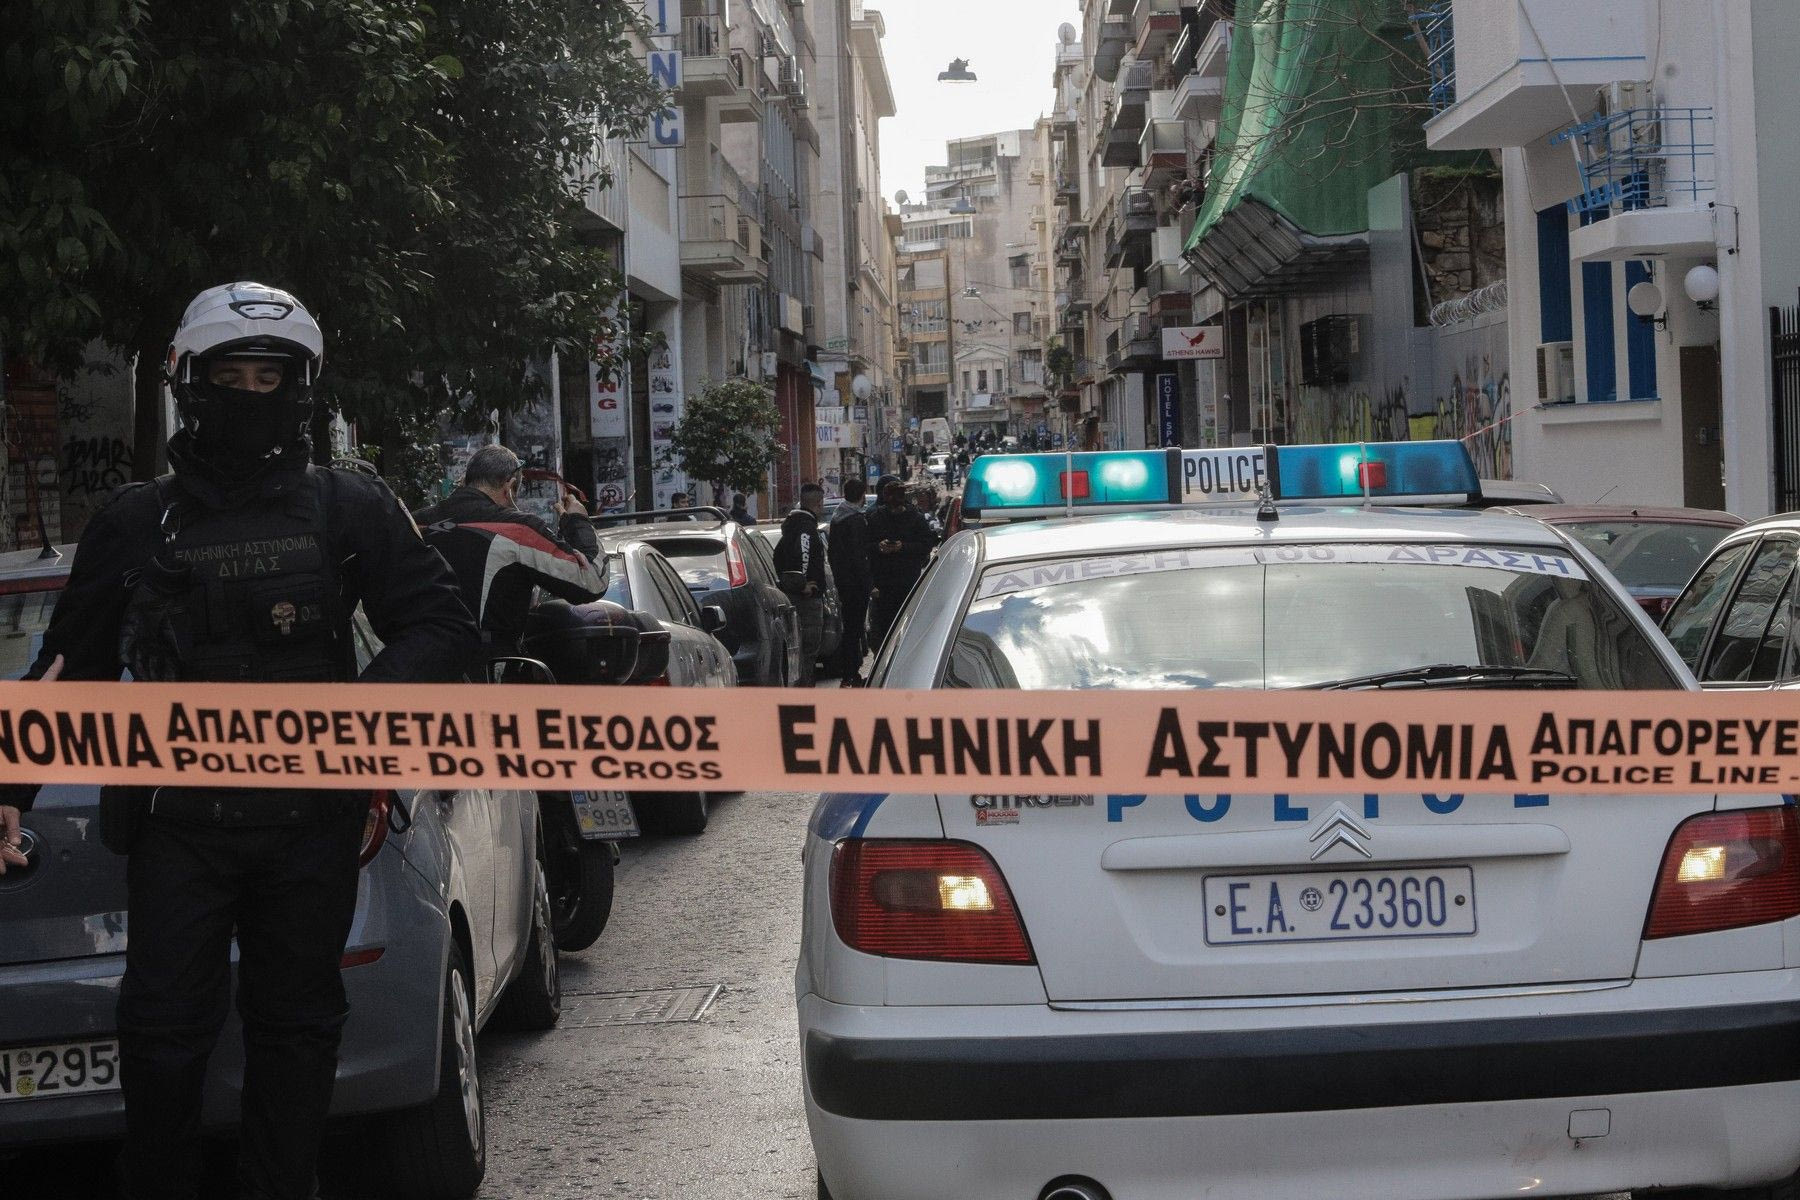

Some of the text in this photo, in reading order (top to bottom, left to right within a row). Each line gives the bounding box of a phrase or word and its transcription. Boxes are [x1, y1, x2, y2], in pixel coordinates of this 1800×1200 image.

[1166, 348, 1221, 357] ATHENS HAWKS
[1164, 378, 1173, 418] HOTEL
[1184, 454, 1266, 495] POLICE
[244, 535, 318, 556] ΑΣΤΥΝΟΜΙΑ
[990, 551, 1190, 595] ΑΜΕΣΗ
[1387, 548, 1571, 575] ΔΡΑΣΗ
[167, 702, 476, 748] ΑΠΑΓΟΡΕΥΕΤΑΙ
[491, 713, 520, 749] Η
[536, 709, 720, 751] ΕΙΣΟΔΟΣ
[778, 704, 1103, 777] ΕΛΛΗΝΙΚΗ
[1146, 706, 1518, 782] ΑΣΤΥΝΟΜΙΑ
[171, 747, 305, 774] POLICE
[315, 749, 403, 776] LINE
[428, 752, 485, 778] DO
[497, 753, 578, 779] NOT
[591, 756, 723, 780] CROSS
[1531, 760, 1674, 785] POLICE
[1690, 760, 1780, 785] LINE
[592, 808, 632, 826] 993
[1228, 880, 1296, 935] E.A.
[1328, 875, 1447, 931] 23360
